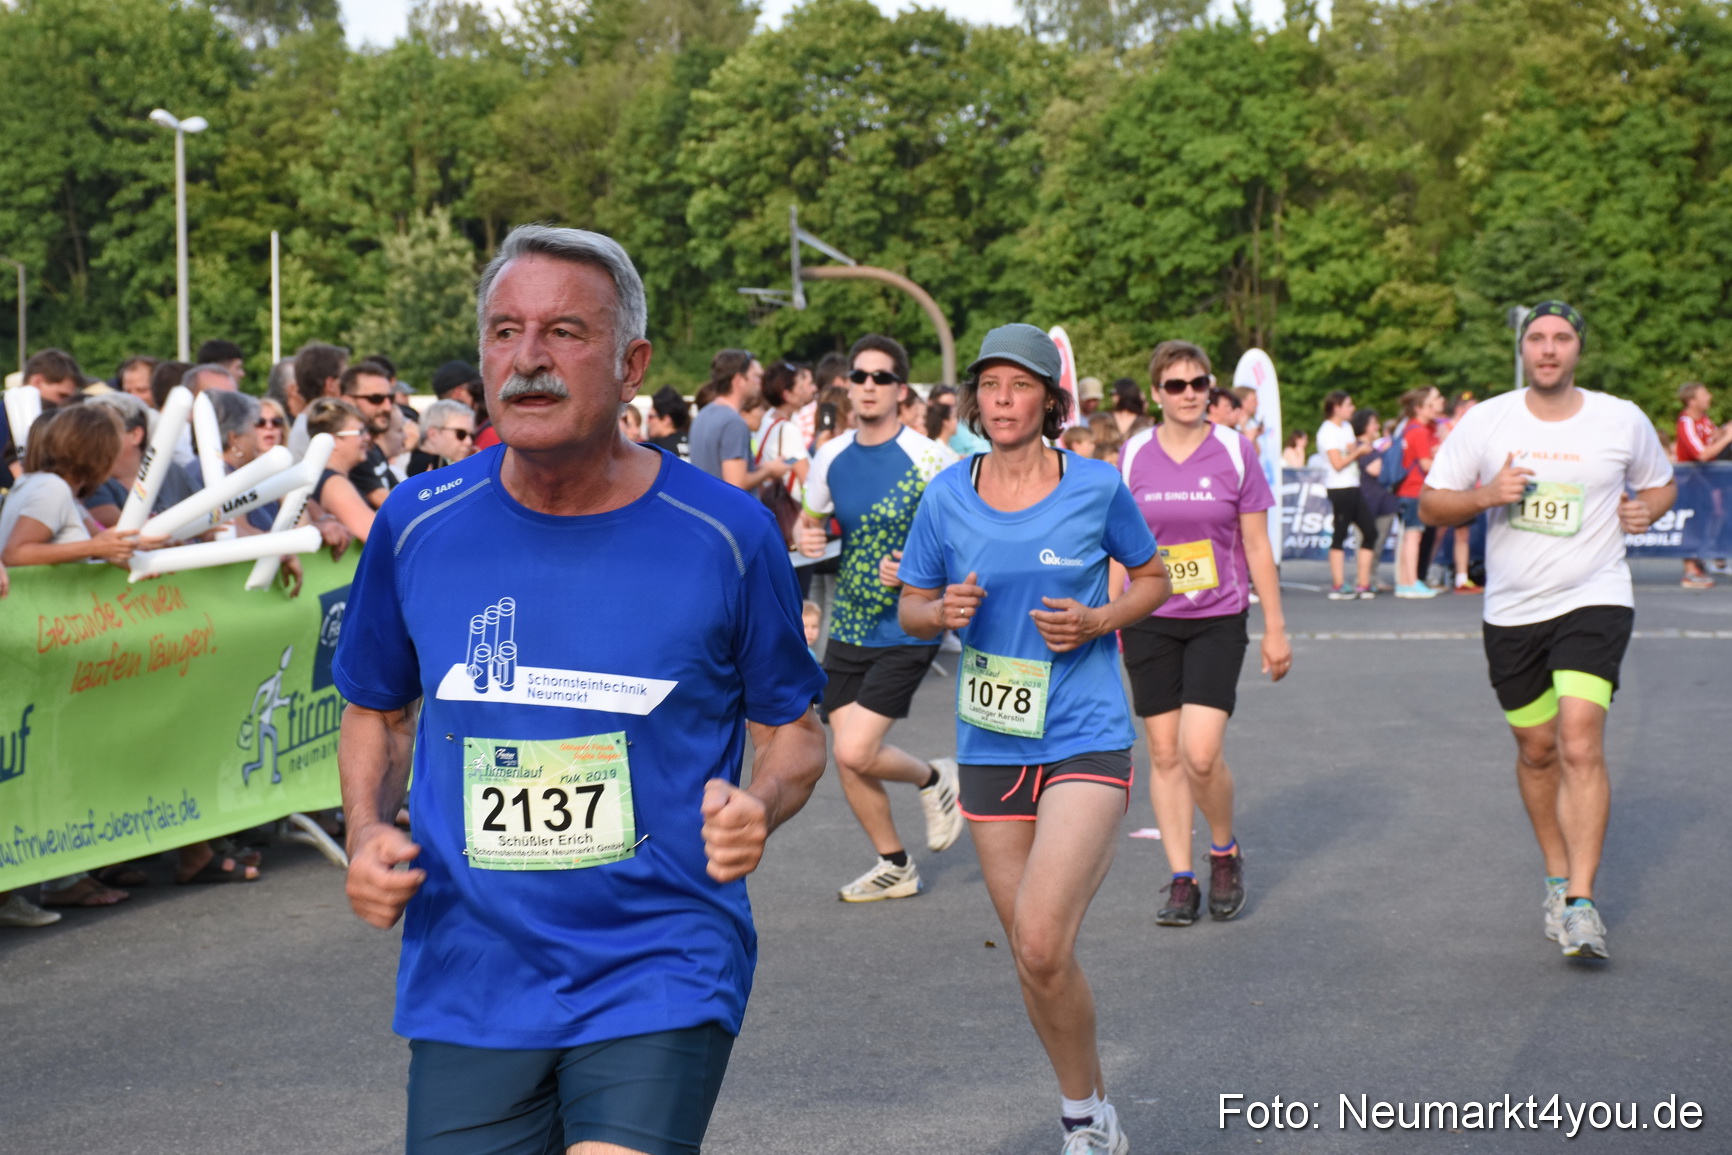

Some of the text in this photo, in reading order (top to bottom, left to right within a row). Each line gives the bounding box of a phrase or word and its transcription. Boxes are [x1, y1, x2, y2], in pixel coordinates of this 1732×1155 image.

[433, 477, 464, 496] JAKO
[1144, 491, 1163, 502] WIR
[1164, 491, 1189, 501] SIND
[1517, 499, 1570, 520] 1191
[37, 584, 189, 654] Gesunde Firmen
[70, 611, 218, 694] laufen länger!
[527, 673, 648, 696] Schornsteintechnik
[527, 687, 589, 703] Neumarkt
[968, 676, 1032, 715] 1078
[998, 711, 1025, 723] Kerstin
[0, 704, 35, 782] uf
[485, 764, 544, 779] firmenlauf
[586, 768, 617, 783] 2019
[481, 784, 606, 832] 2137
[498, 832, 593, 847] Schüßler Erich
